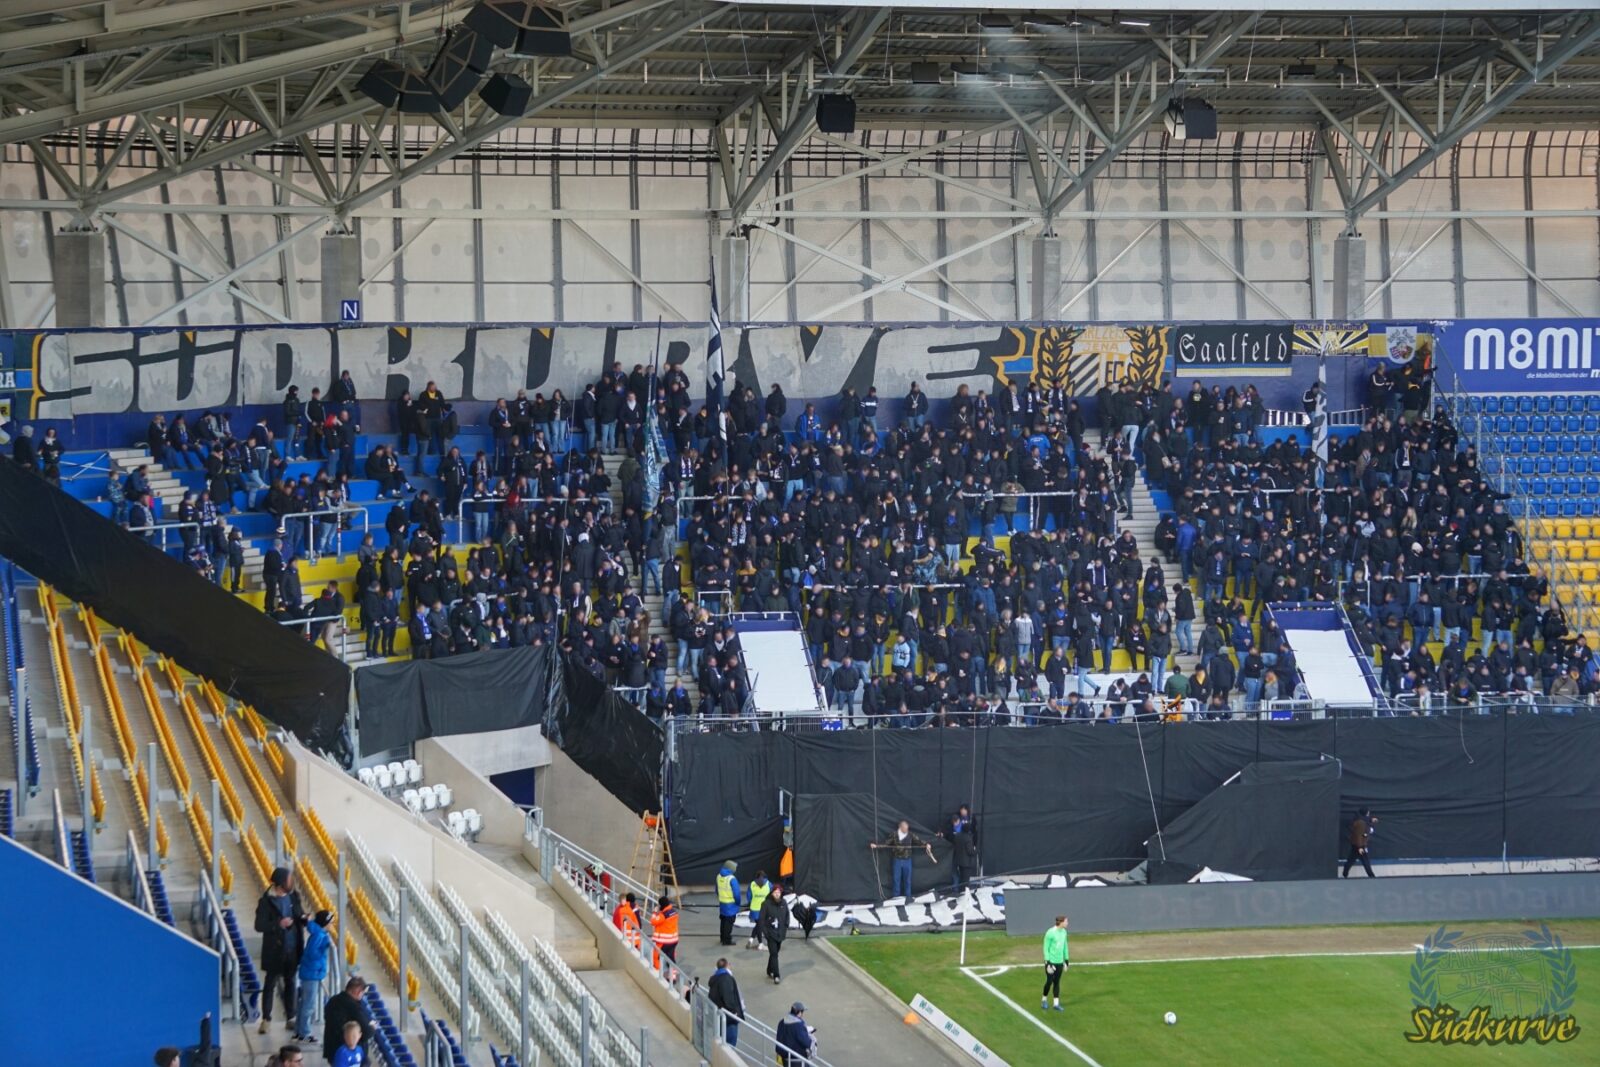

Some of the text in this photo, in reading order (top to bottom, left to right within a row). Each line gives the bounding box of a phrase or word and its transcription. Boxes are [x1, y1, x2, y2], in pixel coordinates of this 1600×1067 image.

[343, 302, 358, 319] N
[1179, 332, 1288, 364] Saalfeld
[0, 371, 16, 388] A
